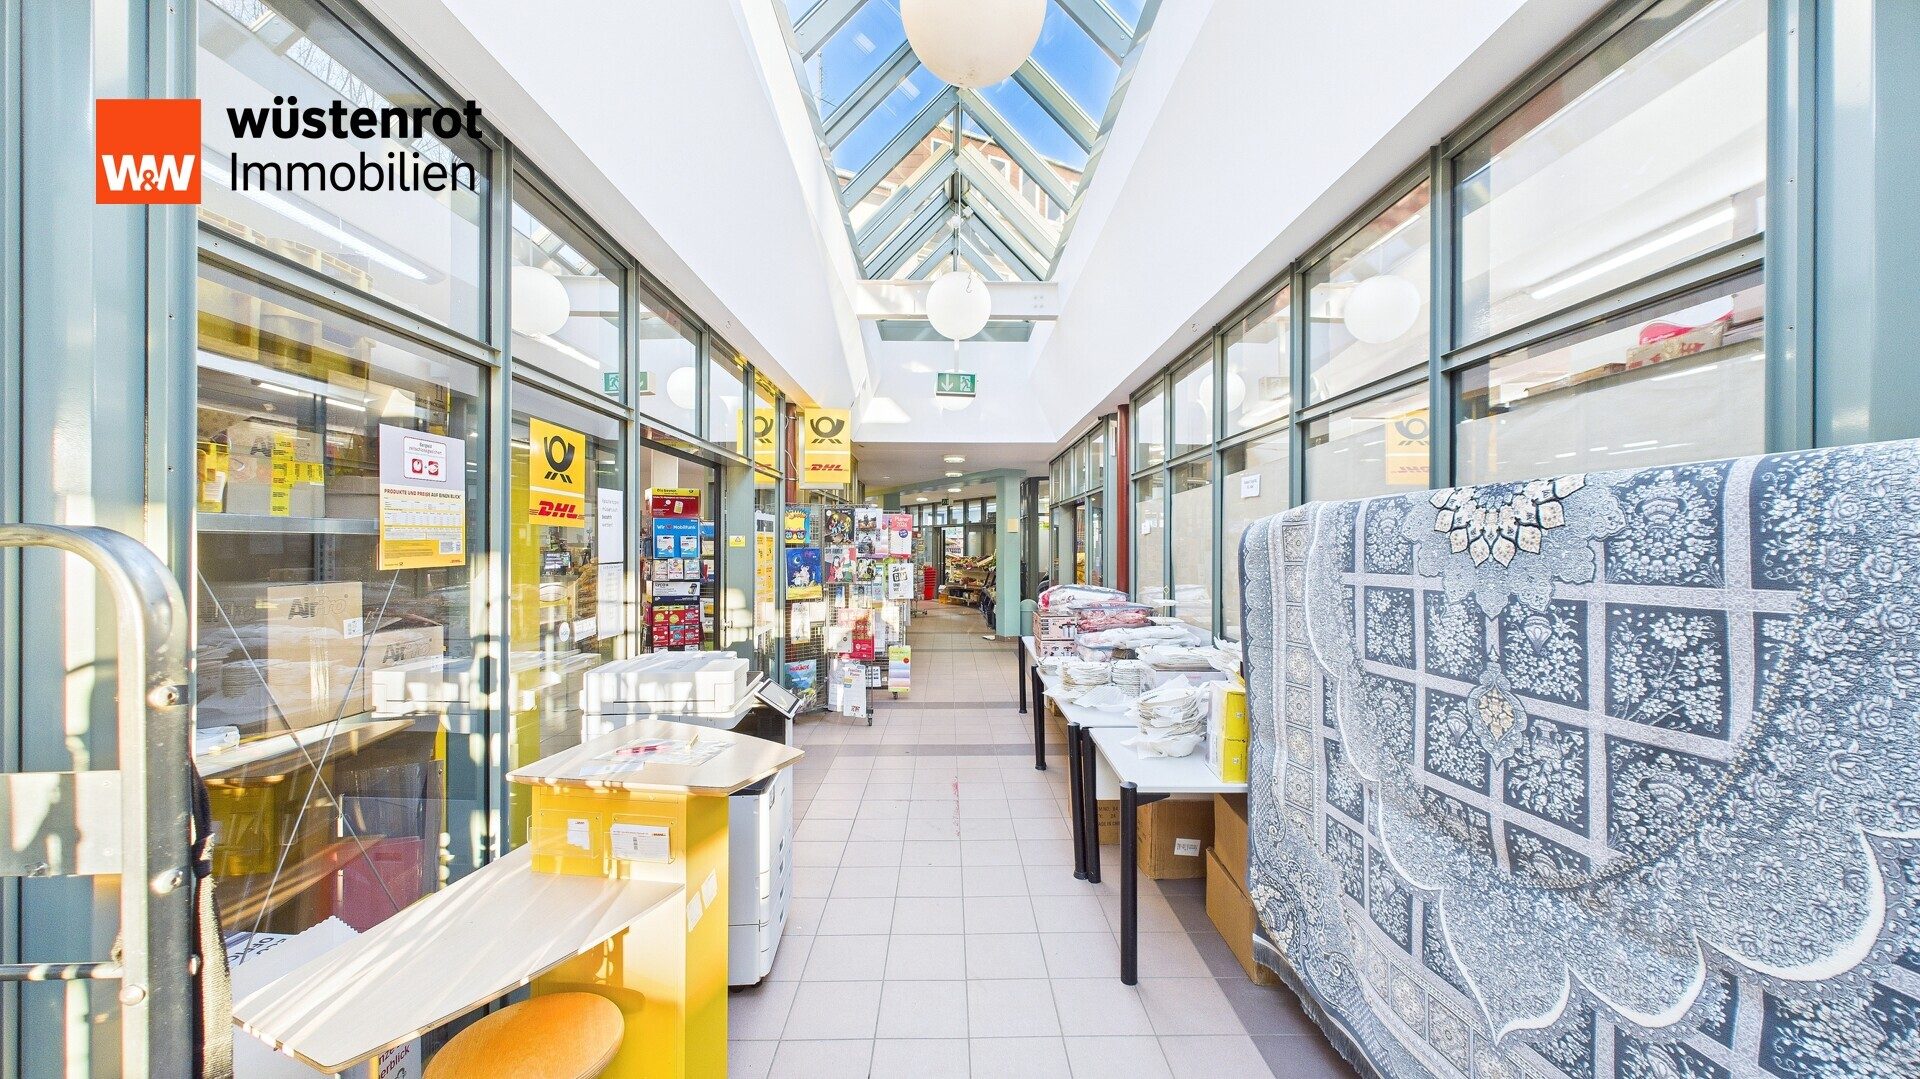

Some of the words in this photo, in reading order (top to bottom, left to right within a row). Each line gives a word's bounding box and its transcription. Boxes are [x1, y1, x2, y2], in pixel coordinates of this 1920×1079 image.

[811, 463, 843, 472] DHL
[384, 488, 407, 496] PRODUKTE
[538, 500, 578, 519] DHL
